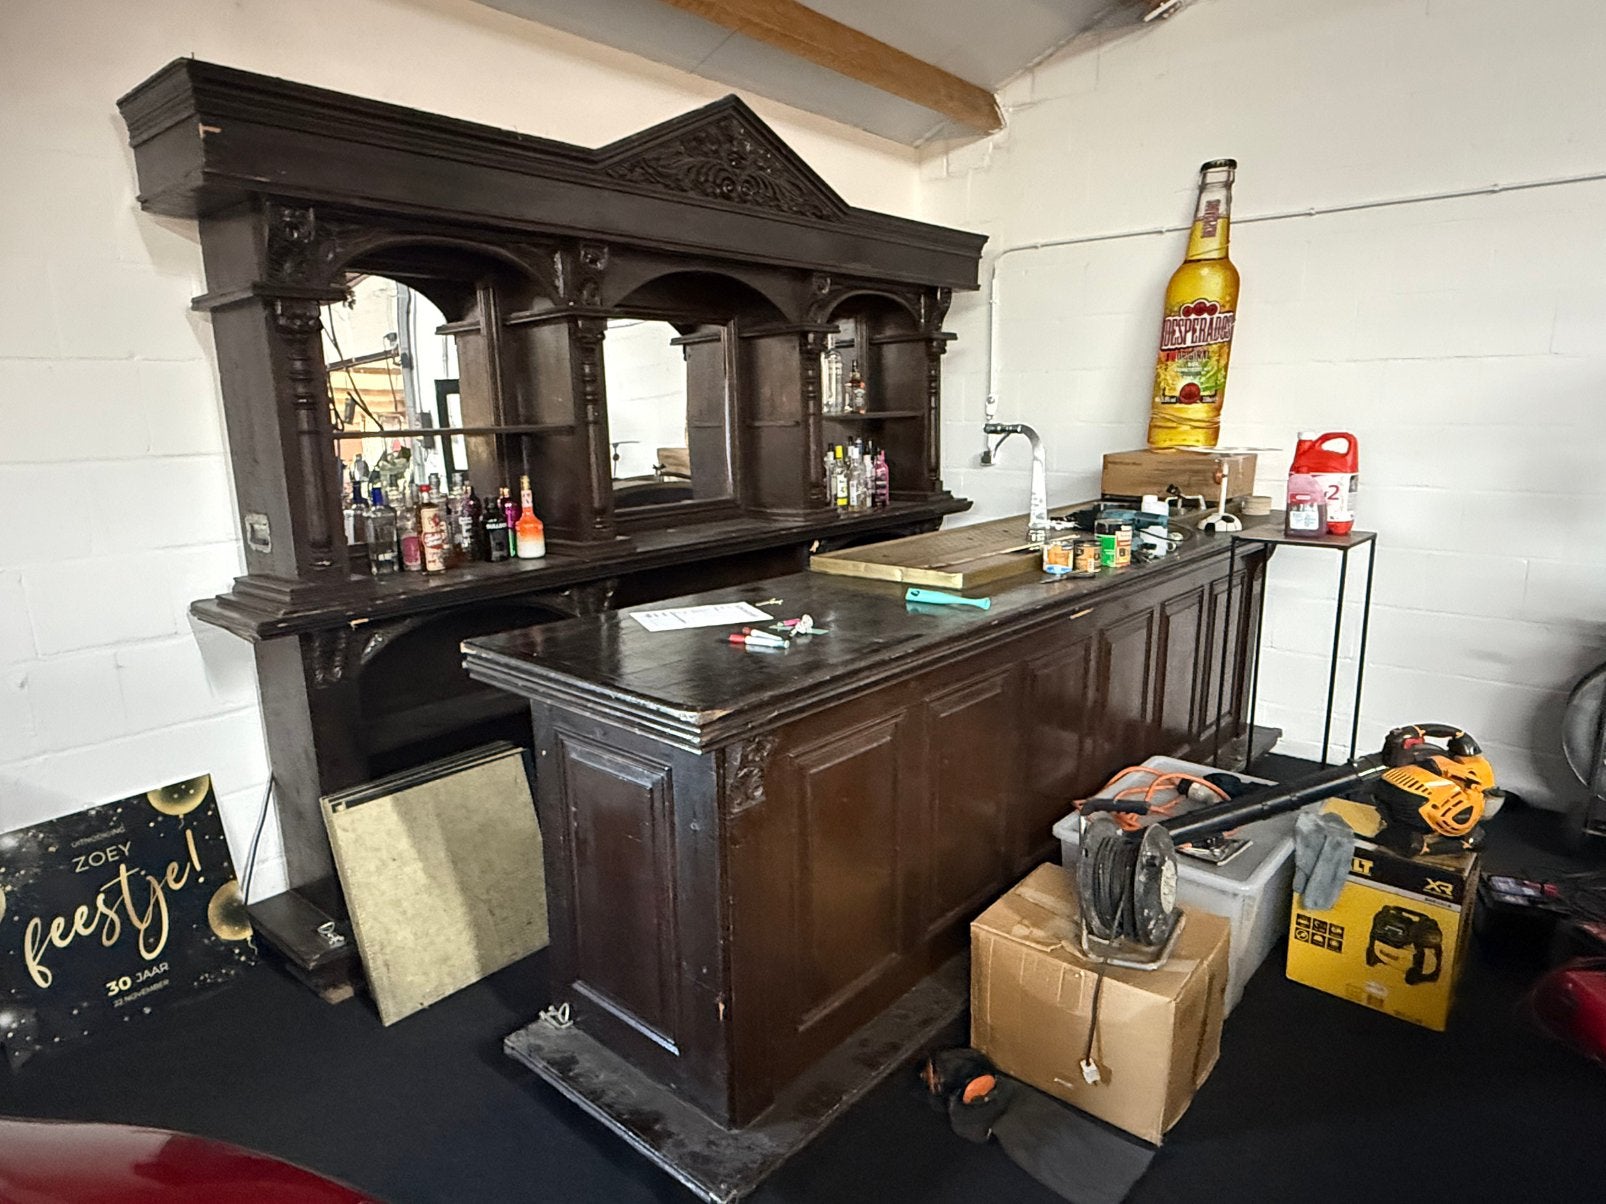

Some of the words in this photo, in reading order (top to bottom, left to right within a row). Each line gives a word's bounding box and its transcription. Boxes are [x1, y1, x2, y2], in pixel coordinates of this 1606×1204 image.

[72, 841, 131, 873] ZOEY
[1422, 877, 1454, 896] XR
[24, 828, 205, 989] feestje!
[105, 976, 132, 997] 30
[135, 962, 169, 983] JAAR
